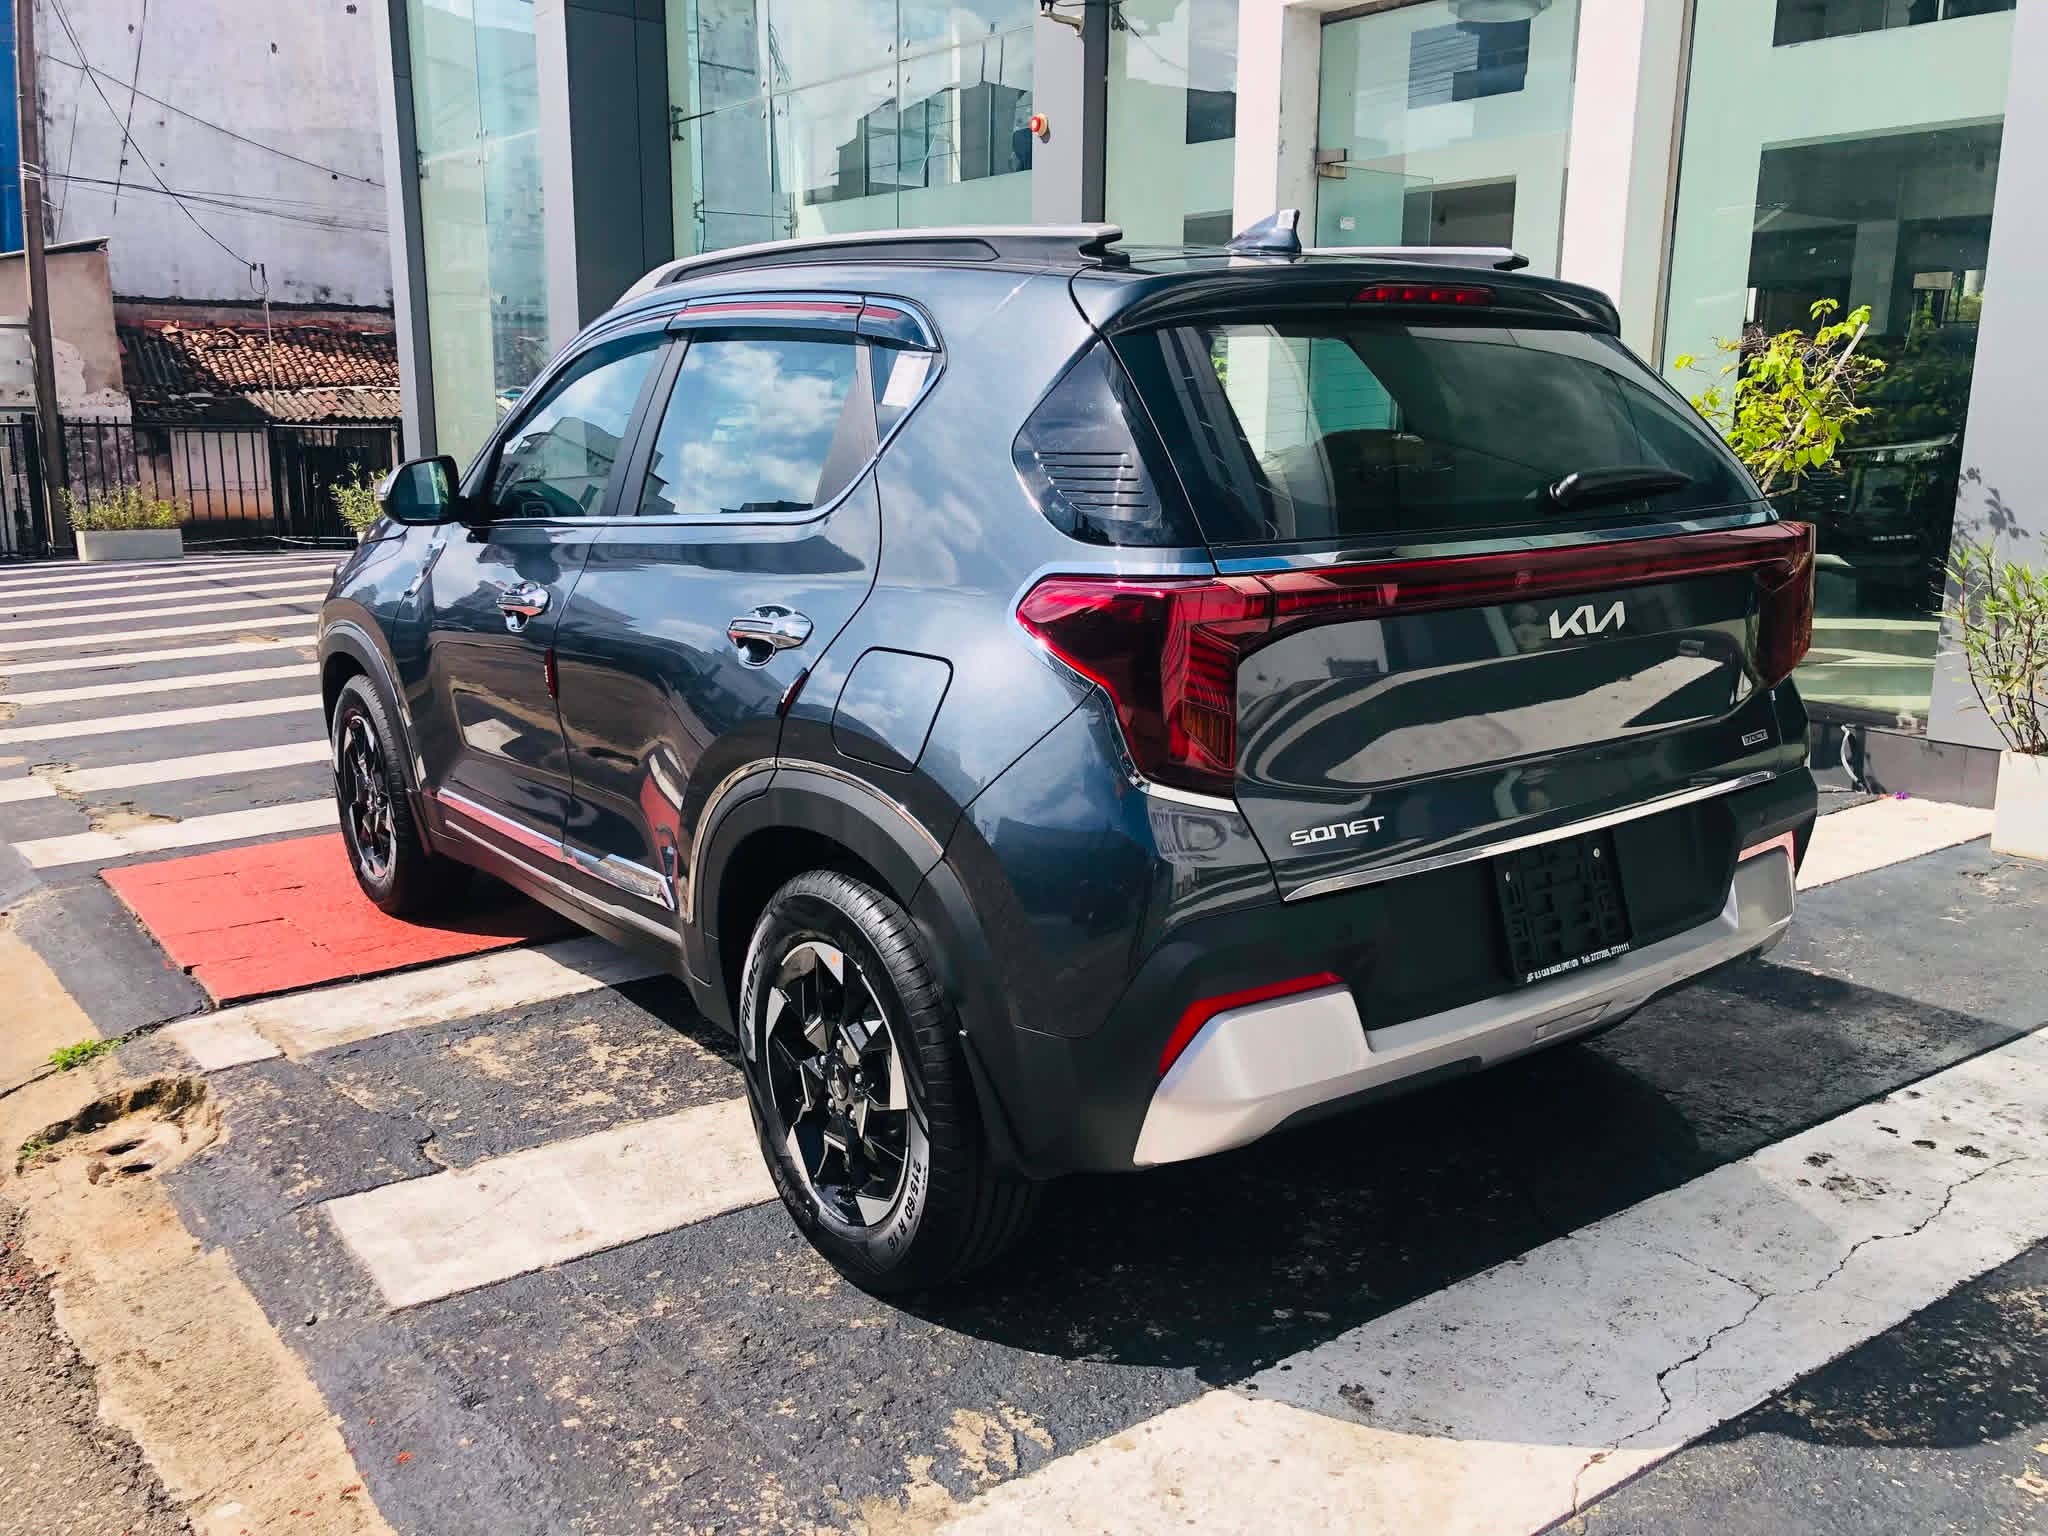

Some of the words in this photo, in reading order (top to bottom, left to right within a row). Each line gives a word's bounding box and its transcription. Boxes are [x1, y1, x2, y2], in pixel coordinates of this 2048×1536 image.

[1549, 601, 1626, 639] KIA
[1290, 816, 1385, 846] SONET
[905, 1160, 922, 1220] 215/60
[888, 1231, 899, 1250] 16
[898, 1218, 907, 1236] R
